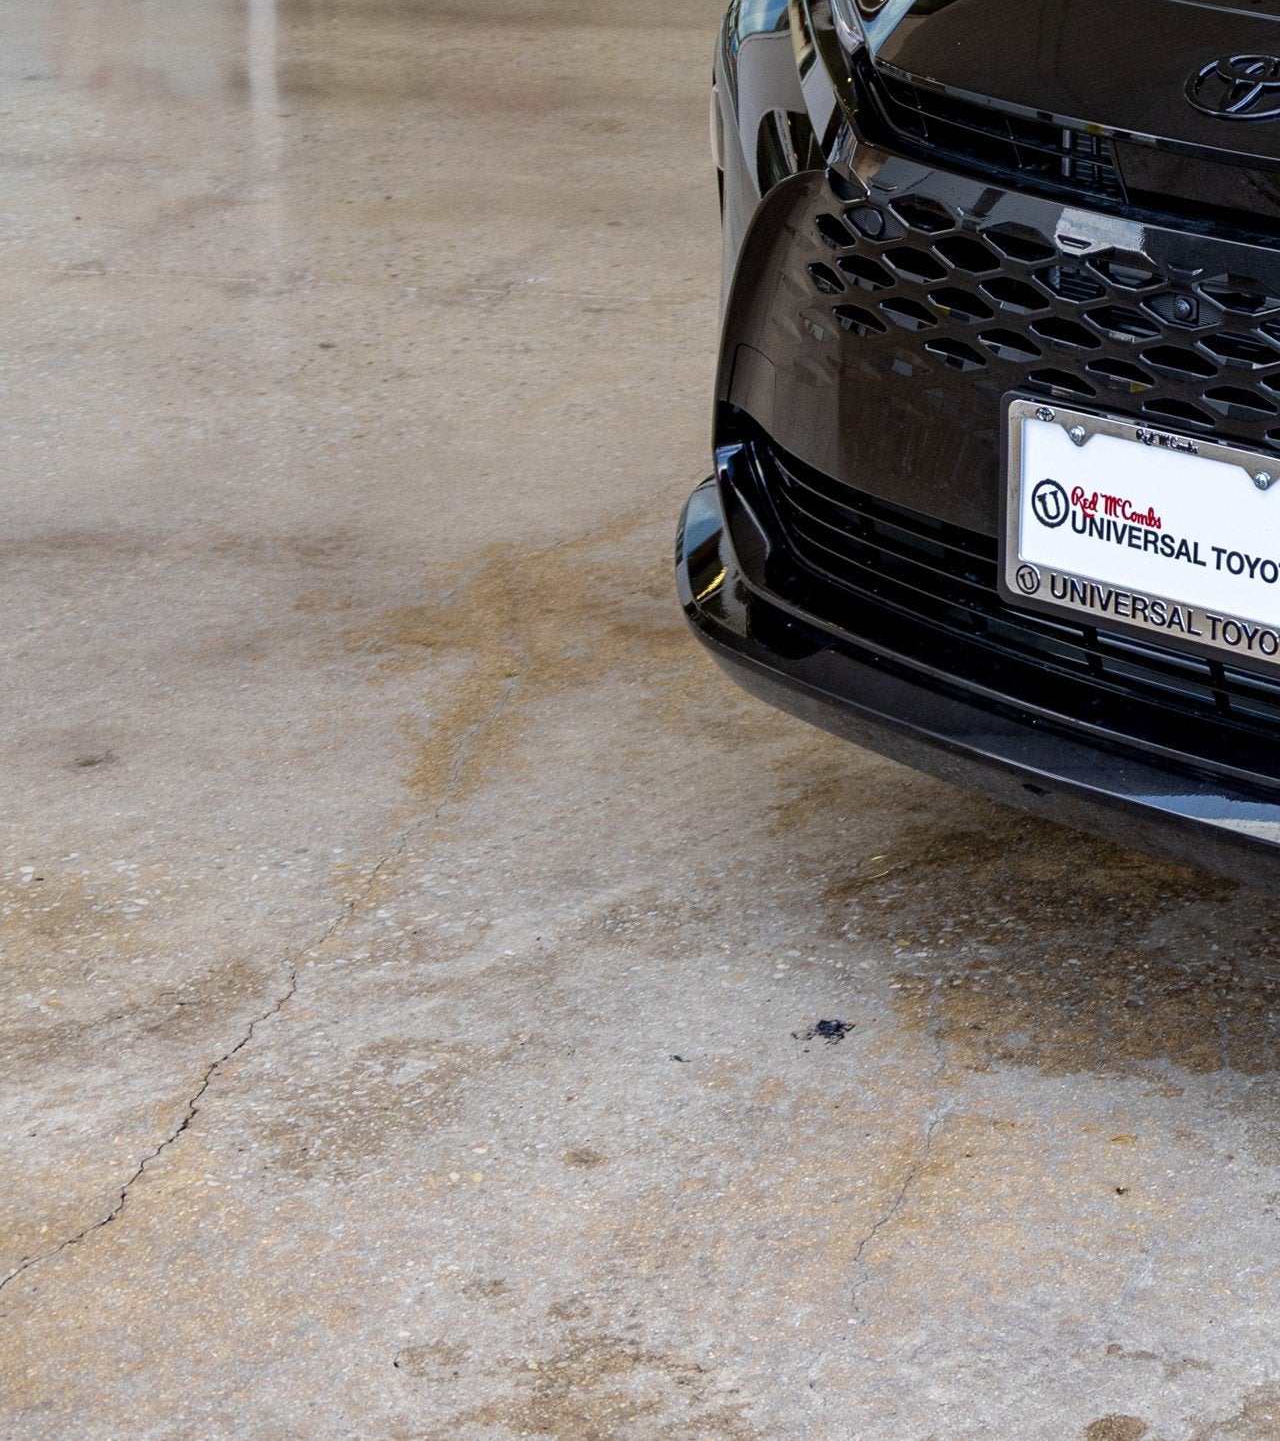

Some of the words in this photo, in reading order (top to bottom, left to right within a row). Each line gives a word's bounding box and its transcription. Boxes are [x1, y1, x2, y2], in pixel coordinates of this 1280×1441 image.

[1071, 486, 1098, 518] Red
[1100, 493, 1162, 530] McCombs
[1071, 509, 1207, 567] UNIVERSAL
[1050, 571, 1203, 636] UNIVERSAL
